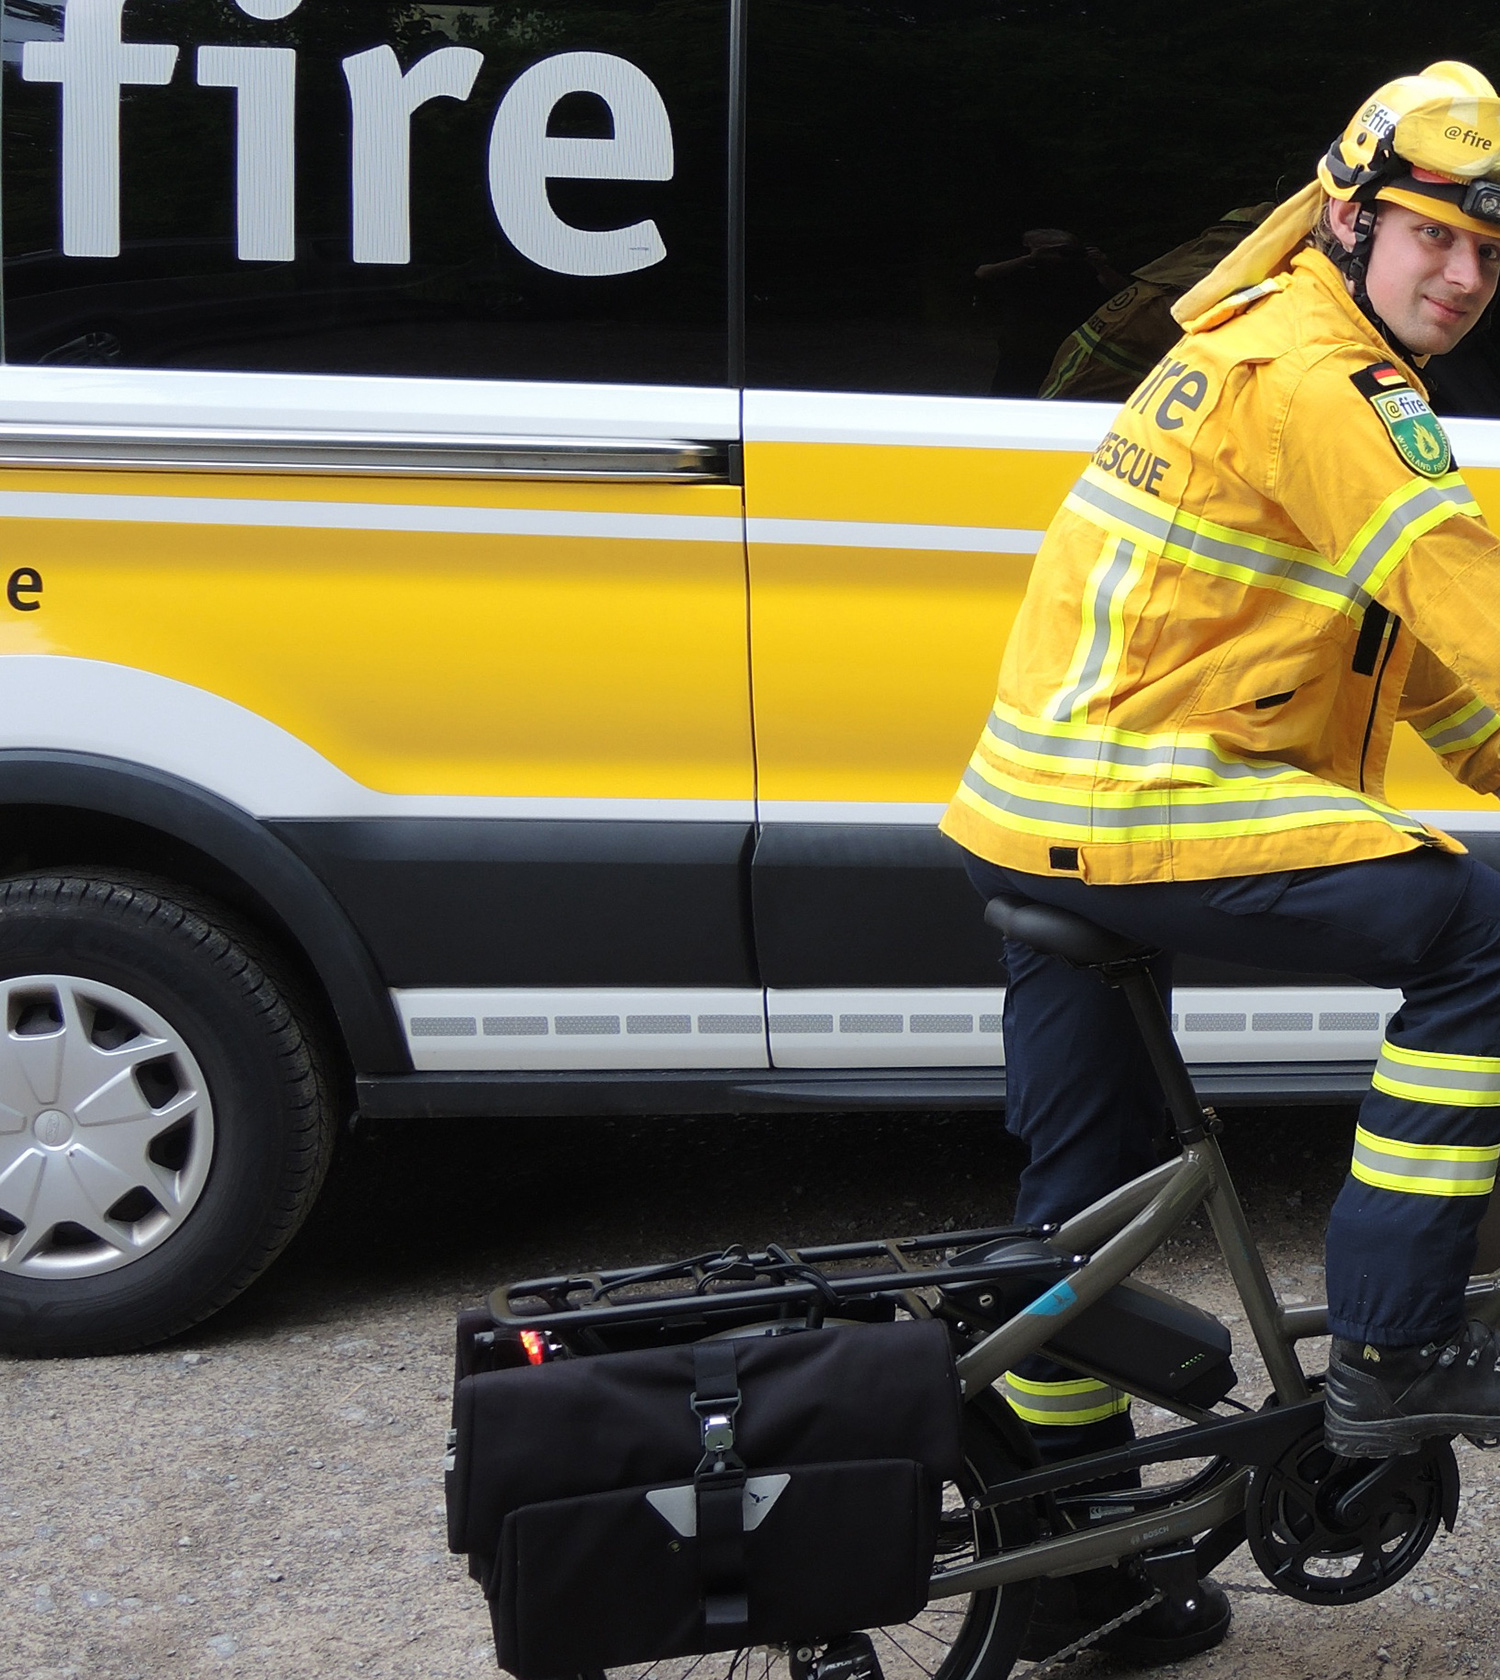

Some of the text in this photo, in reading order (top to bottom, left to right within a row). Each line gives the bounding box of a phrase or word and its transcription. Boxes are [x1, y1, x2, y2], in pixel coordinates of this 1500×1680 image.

[1359, 103, 1396, 137] @fire
[22, 0, 675, 276] fire
[1444, 126, 1493, 151] @fire
[1130, 338, 1208, 430] ire
[1384, 396, 1427, 419] @fire
[1396, 434, 1432, 473] WILDLAND
[1142, 1525, 1169, 1540] BOSCH
